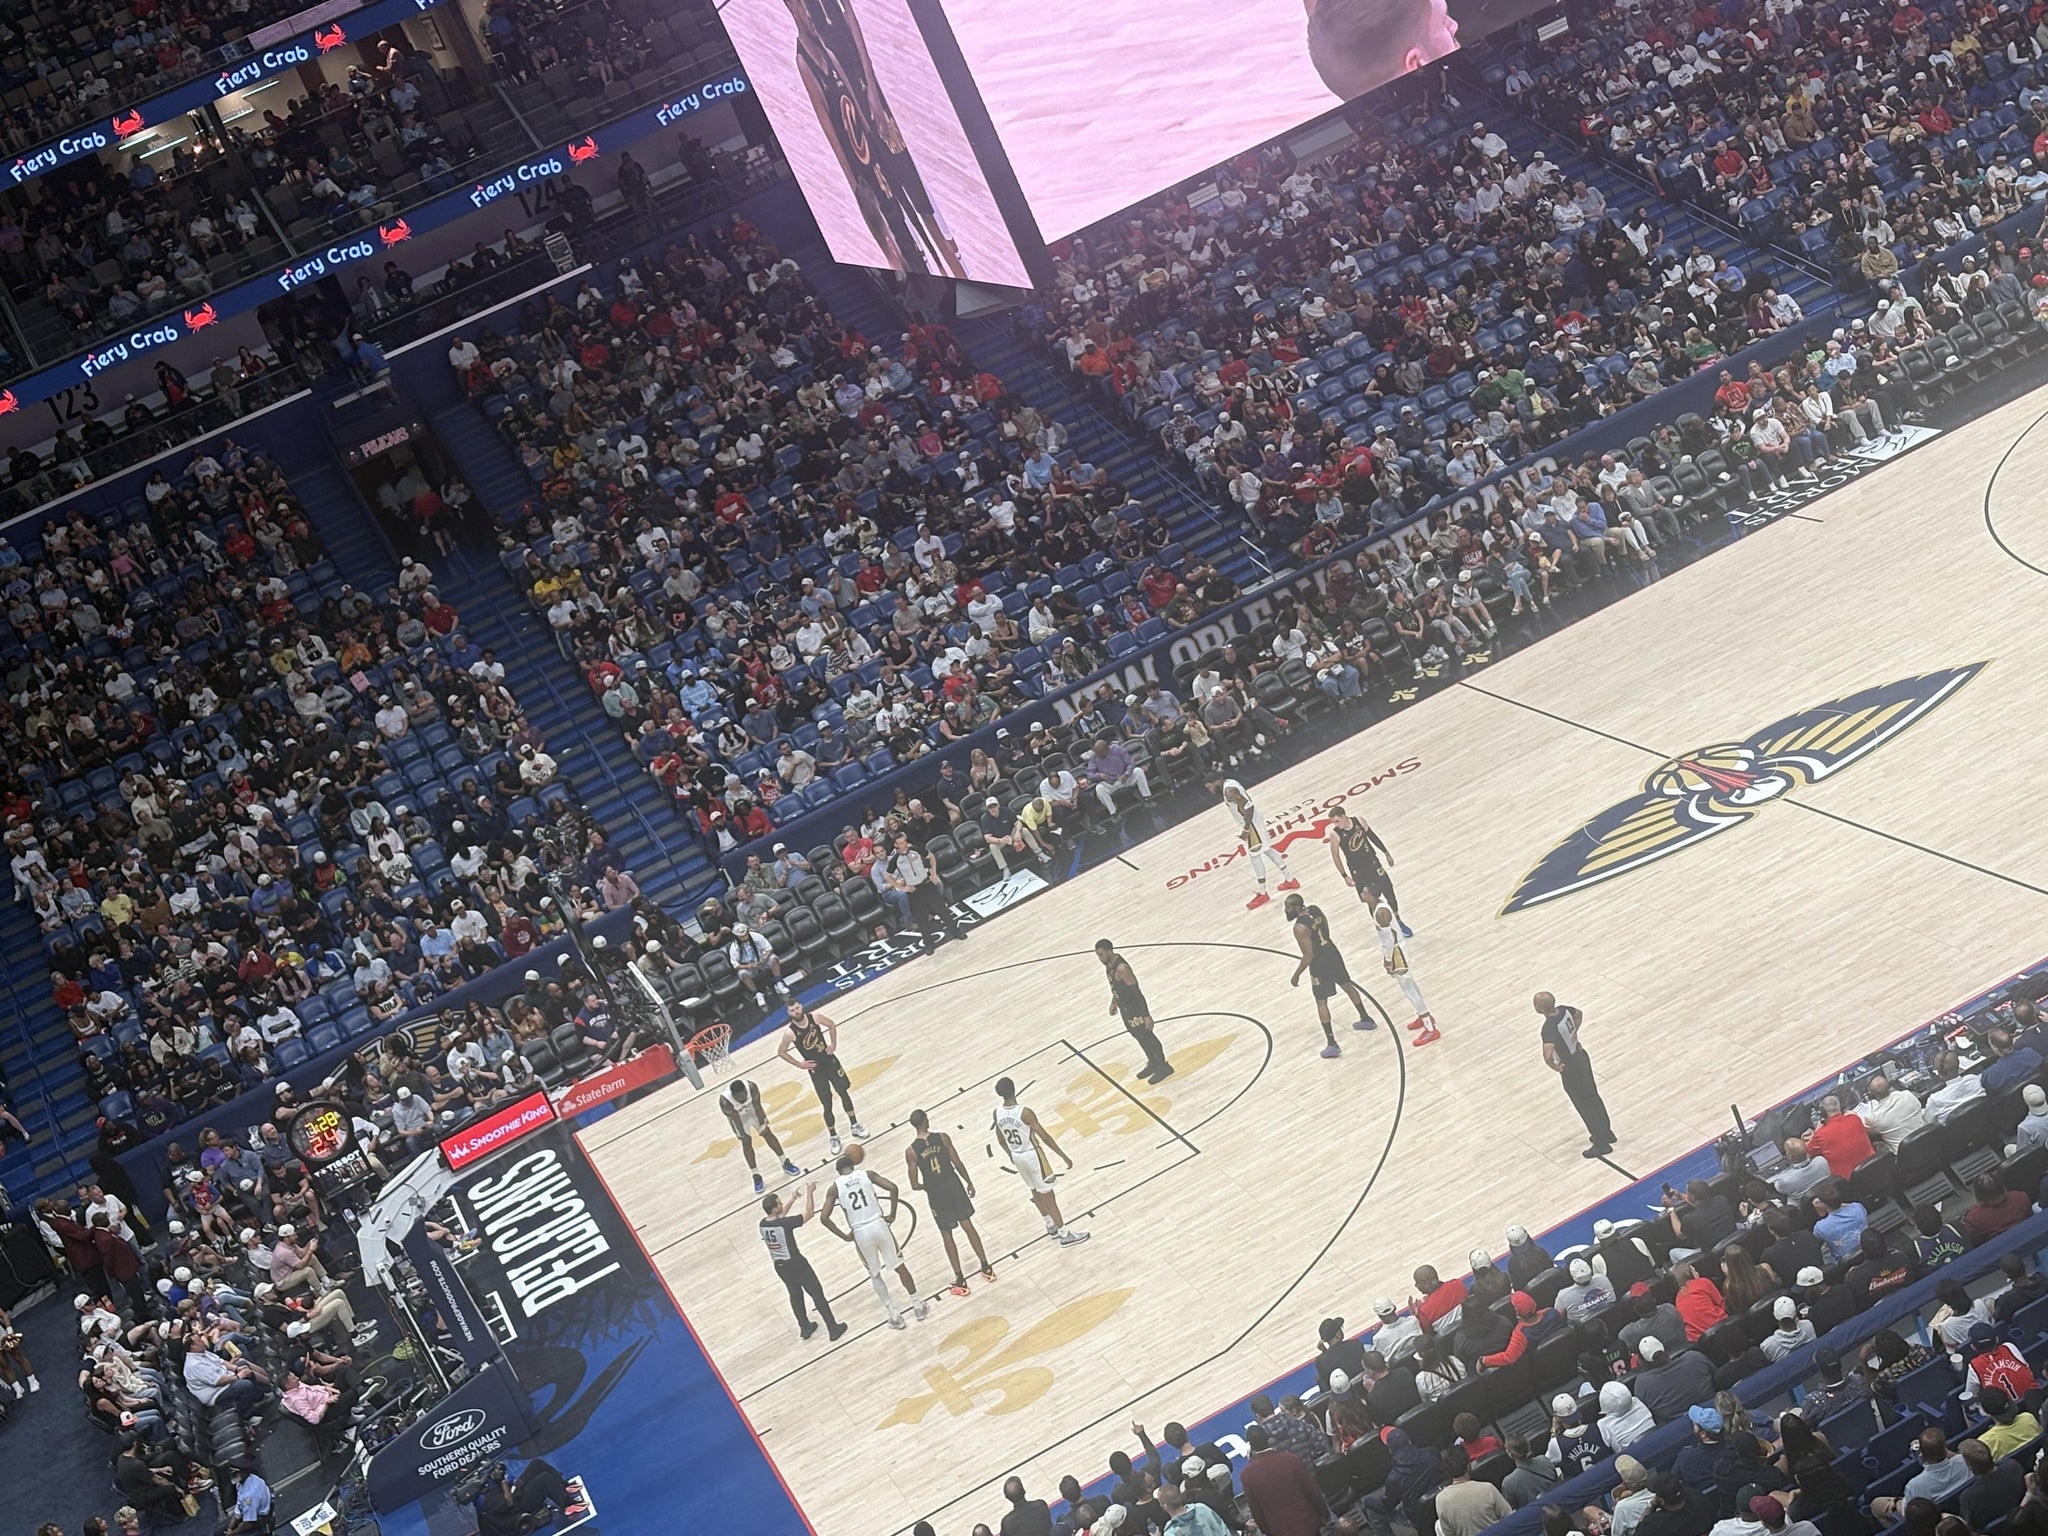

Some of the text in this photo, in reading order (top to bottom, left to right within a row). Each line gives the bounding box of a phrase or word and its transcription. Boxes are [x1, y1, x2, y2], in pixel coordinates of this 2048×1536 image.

[214, 46, 309, 95] Fiery Crab
[655, 77, 746, 127] Fiery Crab
[10, 132, 107, 182] Fiery Crab
[470, 158, 563, 208] Fiery Crab
[278, 241, 374, 292] Fiery Crab
[80, 326, 178, 378] Fiery Crab
[43, 380, 99, 425] 123
[1744, 458, 1881, 527] MORRIS
[469, 1117, 522, 1150] SMOOTHIE
[1003, 1128, 1022, 1146] 25
[326, 1150, 360, 1171] TISSOT
[930, 1156, 941, 1174] 4
[848, 1188, 868, 1211] 21
[467, 1149, 621, 1318] PELICANS
[1868, 1271, 1907, 1291] Budweiser
[1984, 1359, 2021, 1387] WILLIAMSON
[1998, 1372, 2020, 1402] 1
[433, 1414, 475, 1446] Ford
[417, 1425, 507, 1476] SOUTHERN QUALITY
[1567, 1442, 1600, 1461] MURRAY
[432, 1460, 459, 1479] FORD
